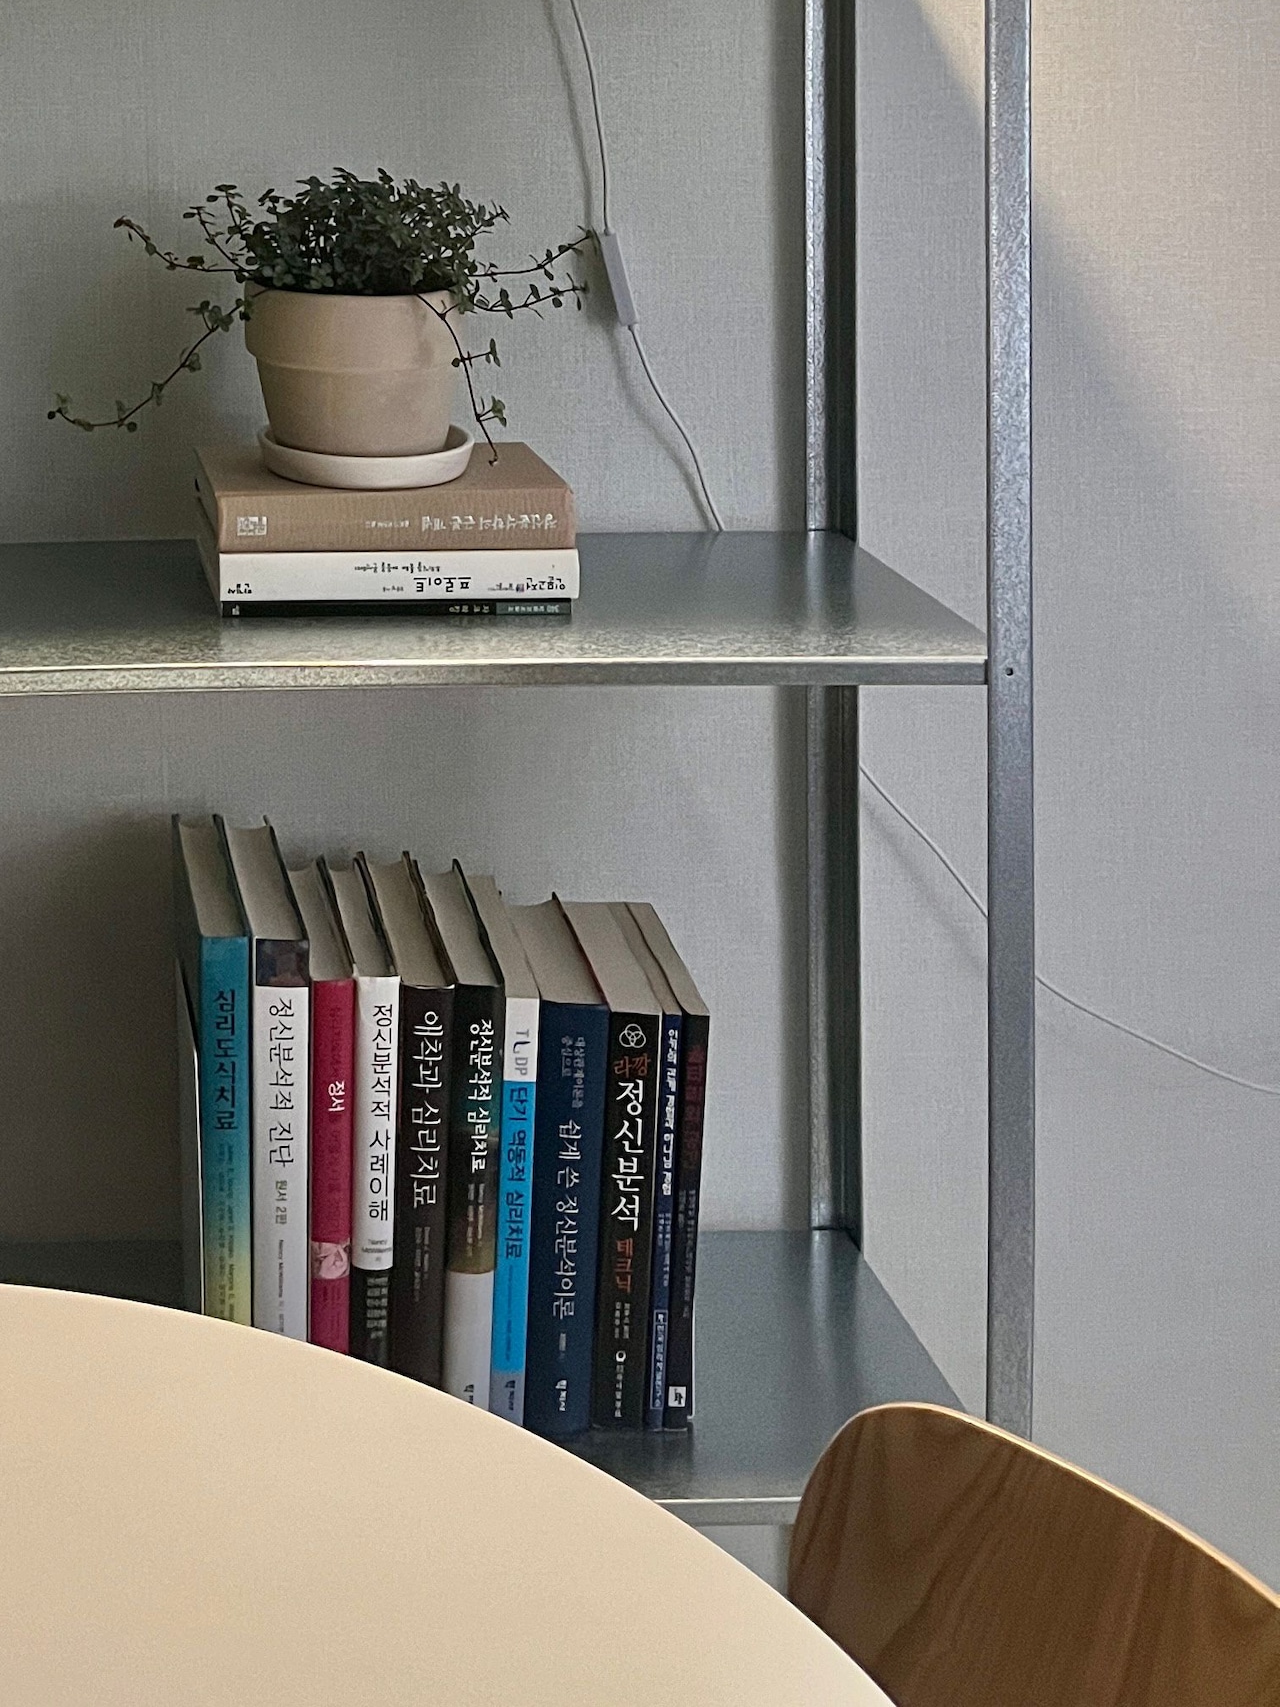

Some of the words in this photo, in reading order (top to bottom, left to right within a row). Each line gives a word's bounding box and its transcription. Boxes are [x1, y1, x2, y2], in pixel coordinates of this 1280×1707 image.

[413, 576, 472, 593] 프로이트
[213, 988, 239, 1131] 심리도식치료
[268, 997, 295, 1111] 정신분석적
[371, 1003, 394, 1121] 정신분석적
[411, 1010, 444, 1094] 애착과
[467, 1018, 495, 1102] 정신분석적
[613, 1053, 651, 1079] 라깡
[508, 1086, 529, 1121] 단기
[268, 1120, 295, 1168] 진단
[409, 1100, 442, 1209] 심리치료
[467, 1106, 491, 1173] 심리치료
[506, 1130, 527, 1182] 역동적
[558, 1119, 582, 1160] 쉽게
[610, 1079, 645, 1232] 정신분석
[368, 1128, 391, 1222] 사례이해
[557, 1166, 580, 1189] 쓴
[505, 1189, 526, 1259] 심리치료
[552, 1194, 580, 1320] 정신분석이론
[614, 1237, 634, 1293] 테크닉
